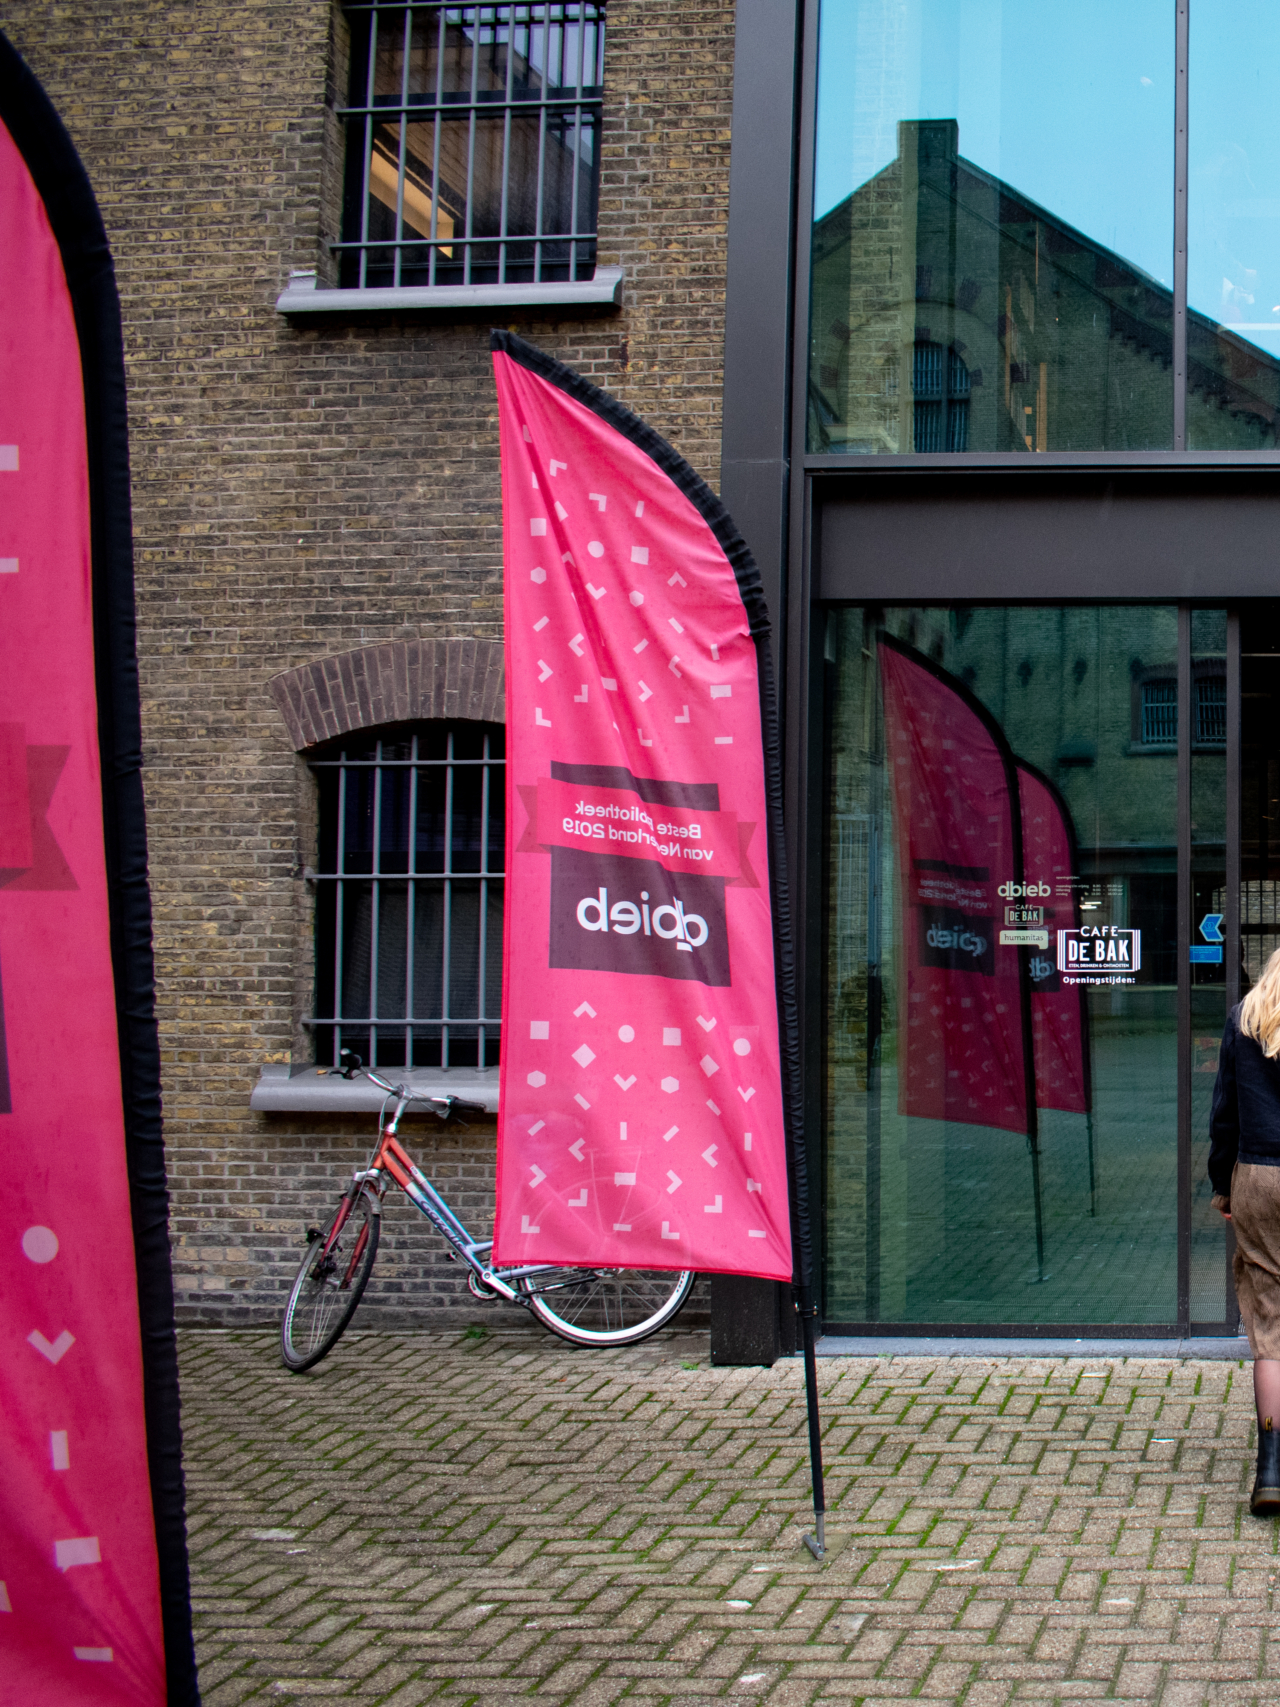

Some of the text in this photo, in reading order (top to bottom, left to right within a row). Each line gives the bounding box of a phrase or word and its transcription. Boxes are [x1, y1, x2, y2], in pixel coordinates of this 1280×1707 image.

[997, 881, 1051, 900] dbieb
[1009, 911, 1038, 921] DE BAK
[1080, 925, 1118, 937] CAFE
[1068, 940, 1129, 961] DE BAK
[1063, 976, 1135, 985] Openingstijden:
